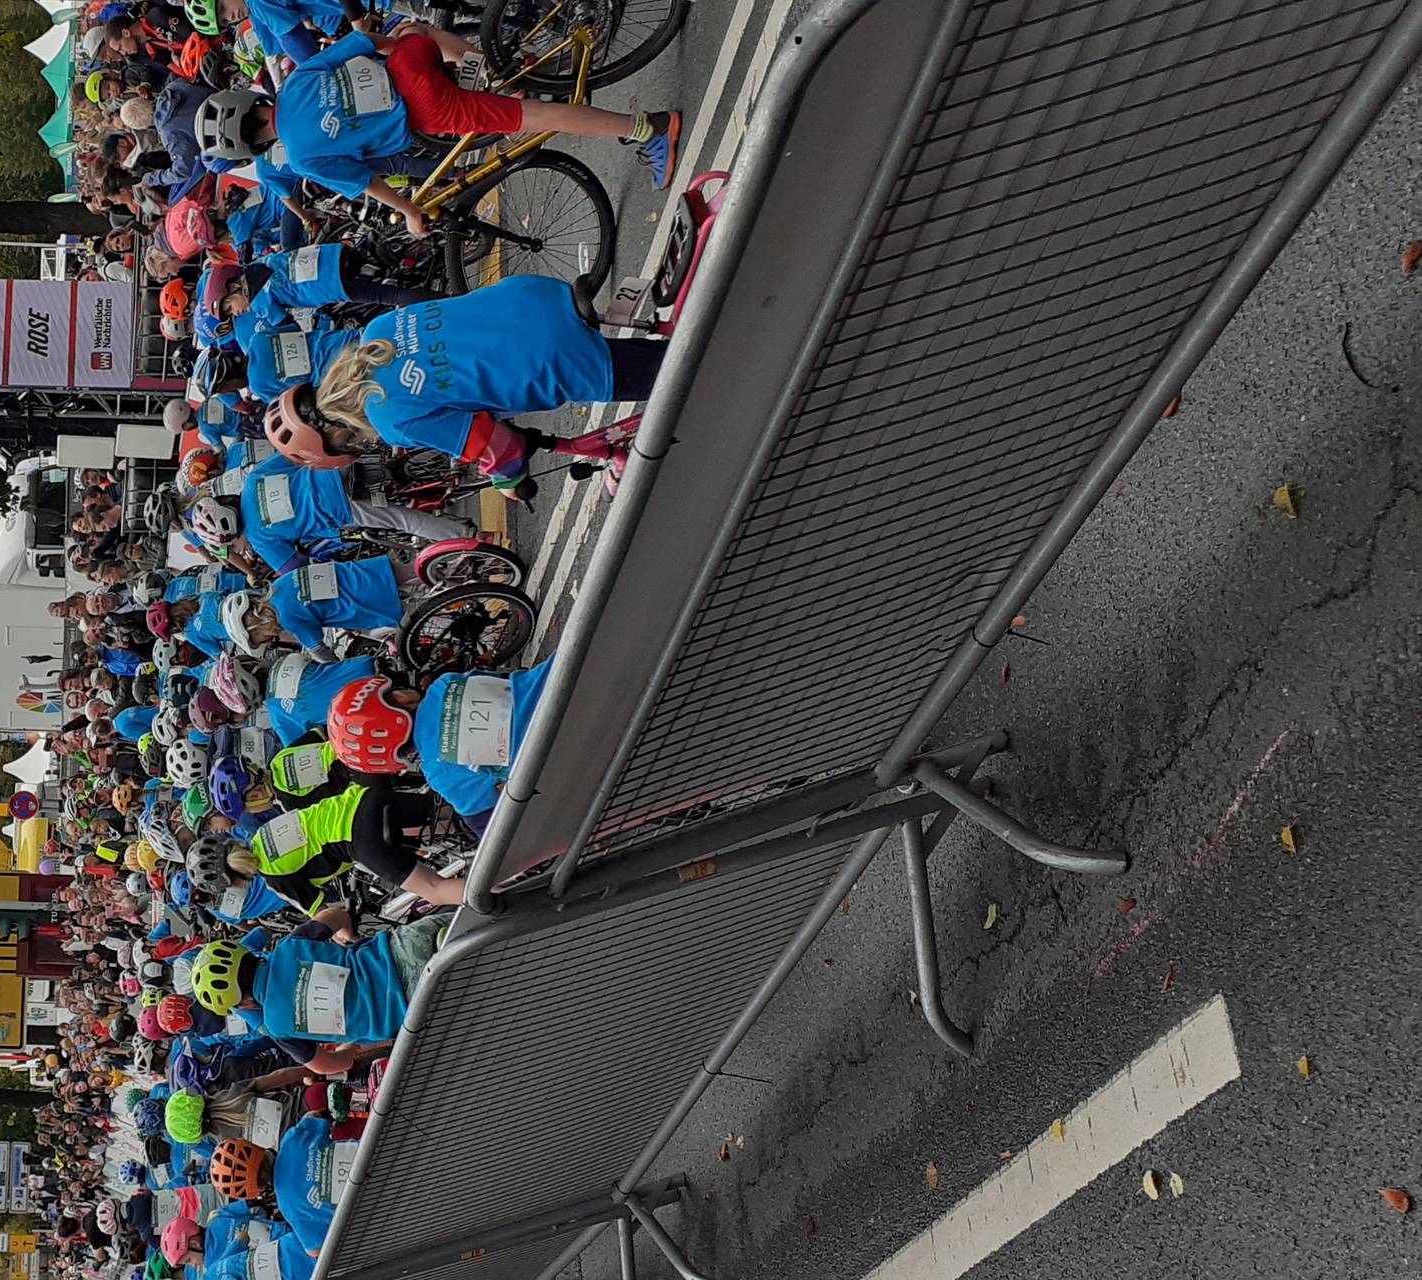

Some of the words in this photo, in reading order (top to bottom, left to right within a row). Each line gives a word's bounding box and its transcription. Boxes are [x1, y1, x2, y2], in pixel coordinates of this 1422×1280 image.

[356, 67, 375, 91] 106
[460, 60, 479, 81] 106
[616, 287, 641, 301] 22
[27, 307, 49, 357] ROSE
[93, 298, 104, 349] Westfälische
[102, 298, 112, 349] Nachrichten
[406, 313, 420, 355] Münster
[100, 352, 111, 369] WN
[286, 343, 298, 361] 126
[269, 490, 282, 503] 18
[281, 665, 294, 679] 95
[346, 678, 387, 714] woom
[467, 700, 492, 734] 121
[244, 740, 255, 753] 88
[198, 781, 209, 807] woom
[276, 824, 290, 837] 13
[313, 985, 329, 1012] 111
[257, 1118, 269, 1135] 29
[257, 1252, 269, 1271] 177
